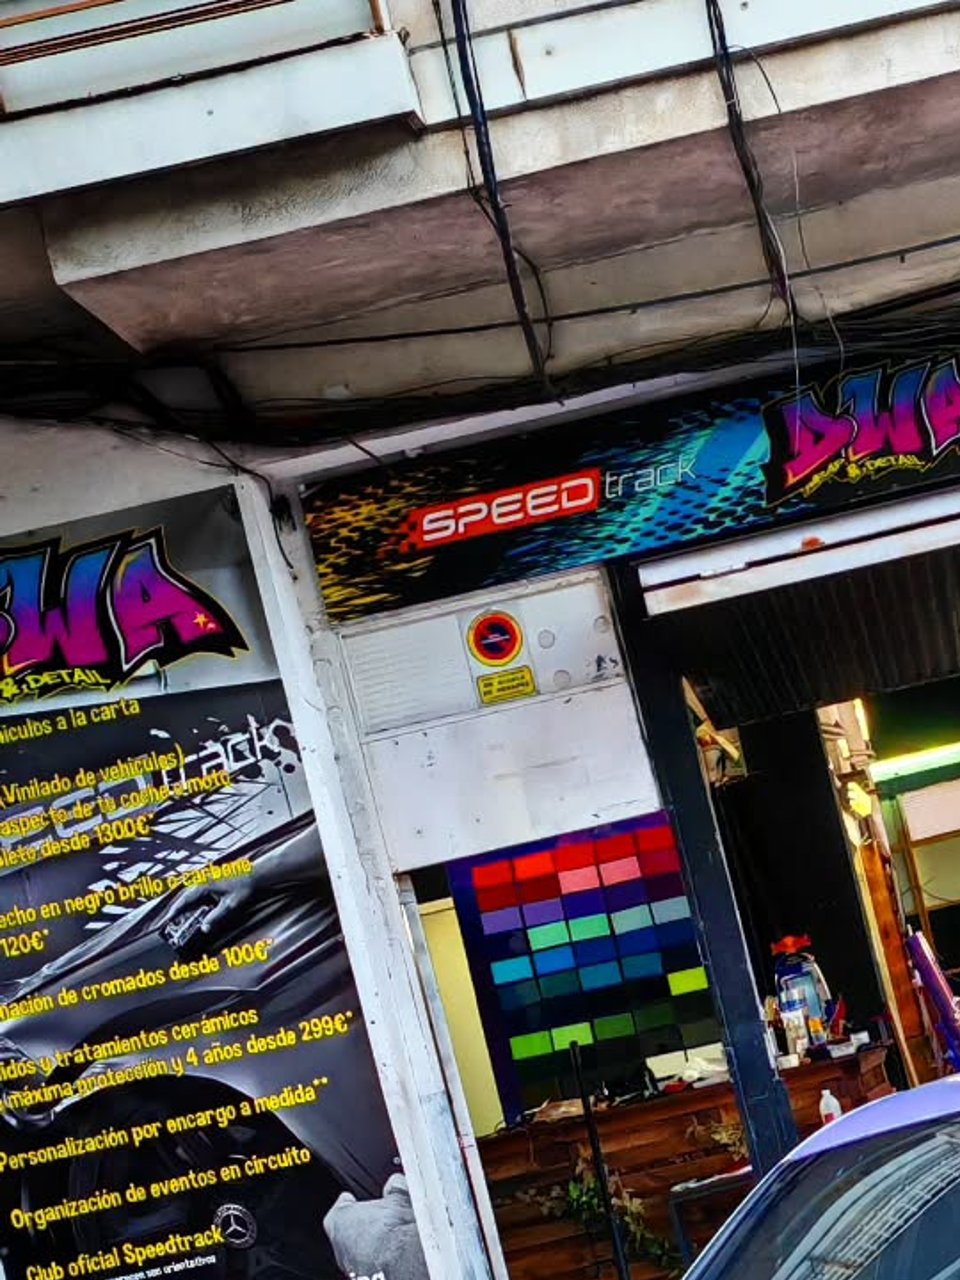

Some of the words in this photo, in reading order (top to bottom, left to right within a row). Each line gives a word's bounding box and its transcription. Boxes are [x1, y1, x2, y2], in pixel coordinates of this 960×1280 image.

[421, 477, 595, 542] SPEED
[604, 456, 697, 499] track
[0, 545, 225, 672] WA
[24, 668, 110, 691] DETAIL
[56, 715, 68, 730] a
[69, 708, 87, 729] la
[90, 698, 140, 723] carta
[1, 808, 67, 837] aspecto
[73, 799, 93, 819] de
[120, 784, 169, 808] coche
[187, 769, 231, 793] moto
[76, 767, 96, 787] de
[41, 833, 91, 857] desde
[41, 901, 61, 919] en
[65, 888, 115, 914] negro
[118, 873, 163, 903] brillo
[182, 857, 253, 887] carbono
[58, 988, 78, 1007] de
[82, 969, 166, 1000] cromados
[169, 953, 220, 981] desde
[0, 1058, 36, 1082] idos
[40, 1056, 52, 1077] y
[55, 1029, 168, 1067] tratamientos
[171, 1008, 259, 1041] cerámicos
[8, 1081, 73, 1109] máxima
[77, 1058, 167, 1095] protección
[171, 1056, 184, 1077] y
[186, 1046, 199, 1067] 4
[203, 1042, 243, 1065] años
[247, 1027, 296, 1054] desde
[0, 1125, 129, 1173] Personalización
[131, 1119, 162, 1147] por
[166, 1103, 236, 1133] encargo
[239, 1100, 252, 1117] a
[10, 1188, 122, 1230] Organización
[125, 1182, 147, 1204] de
[150, 1166, 217, 1199] eventos
[220, 1161, 241, 1182] en
[244, 1146, 311, 1177] circuito
[68, 1247, 121, 1277] oficial
[122, 1224, 225, 1267] Speedtrack
